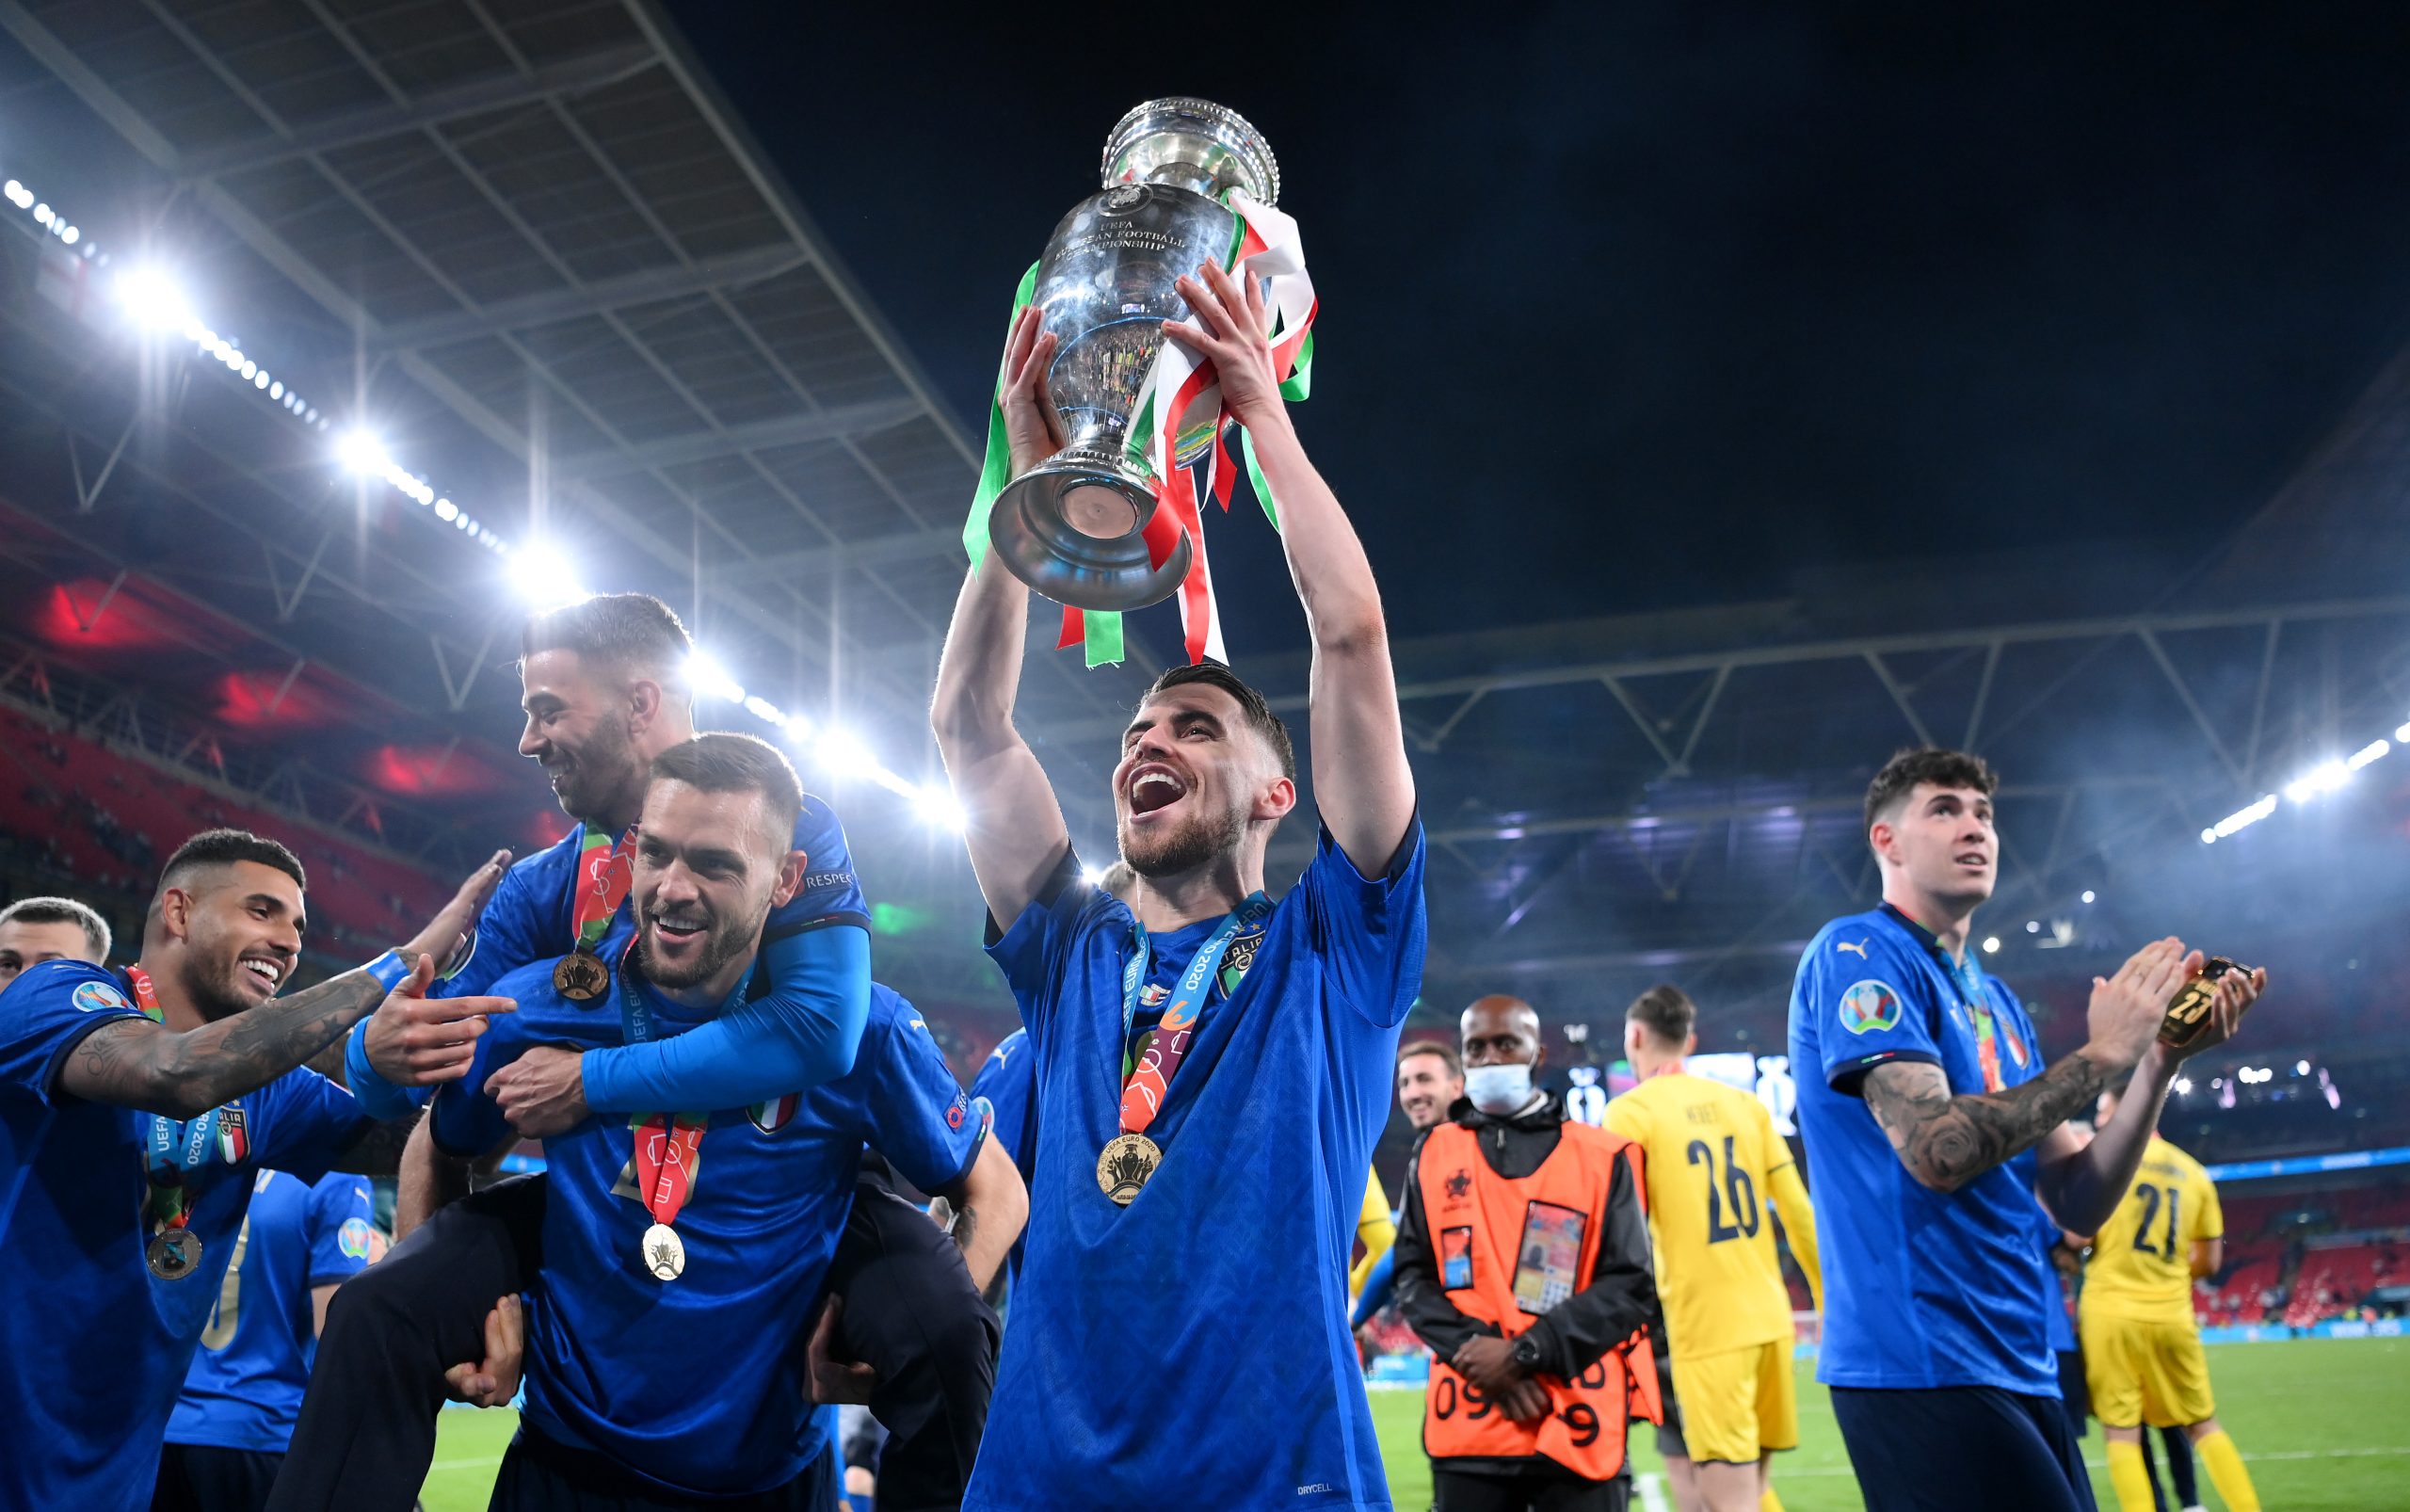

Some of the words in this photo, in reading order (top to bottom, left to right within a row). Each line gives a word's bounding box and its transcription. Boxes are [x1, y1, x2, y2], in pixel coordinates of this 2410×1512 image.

[1101, 220, 1133, 232] UEFA
[1117, 230, 1186, 249] FOOTBALL
[805, 872, 854, 889] RESPEC
[1220, 937, 1263, 965] TALIA
[1185, 955, 1212, 991] 2020
[218, 1111, 243, 1122] ALIA
[155, 1115, 170, 1152] UEFA
[186, 1131, 205, 1166] 2020
[1105, 1140, 1121, 1154] UEFA
[1141, 1138, 1156, 1152] 2020
[1687, 1134, 1759, 1245] 26
[2133, 1182, 2179, 1260] 21
[1297, 1482, 1333, 1496] DRYCELL
